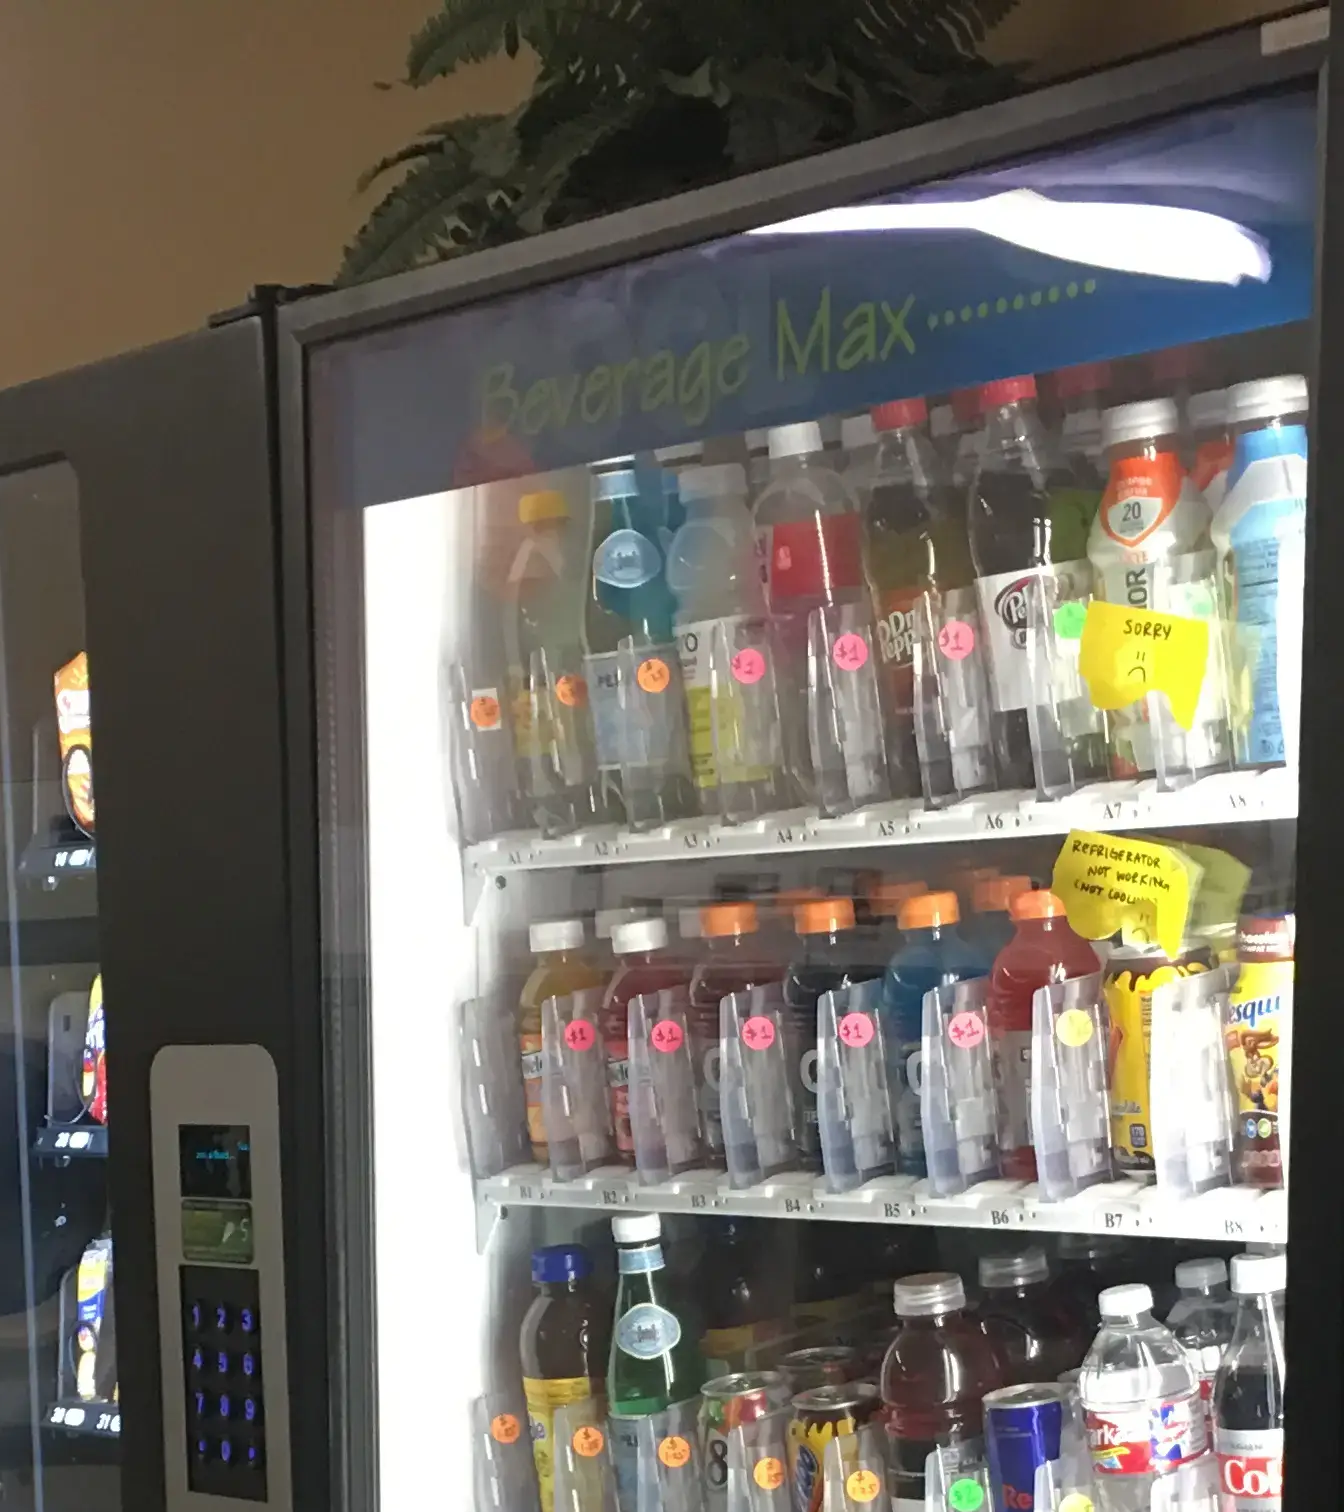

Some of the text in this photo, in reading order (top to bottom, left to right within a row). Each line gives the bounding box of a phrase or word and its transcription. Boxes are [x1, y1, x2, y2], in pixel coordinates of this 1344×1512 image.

[476, 279, 920, 438] Beverage Max
[1122, 501, 1142, 522] 20
[1123, 619, 1172, 640] SORRY
[1103, 802, 1122, 819] A7
[877, 820, 897, 837] A5
[985, 813, 1006, 831] A6
[775, 827, 794, 844] A4
[1072, 840, 1161, 869] REFRIGERATOR
[1087, 865, 1170, 893] NOT WORKING
[692, 1195, 707, 1209] B3
[785, 1199, 801, 1213] B4
[884, 1203, 901, 1218] B5
[992, 1210, 1010, 1225] B6
[1105, 1213, 1123, 1228] B7
[192, 1304, 201, 1328] 1
[216, 1306, 227, 1329] 2
[1002, 1483, 1033, 1510] Re
